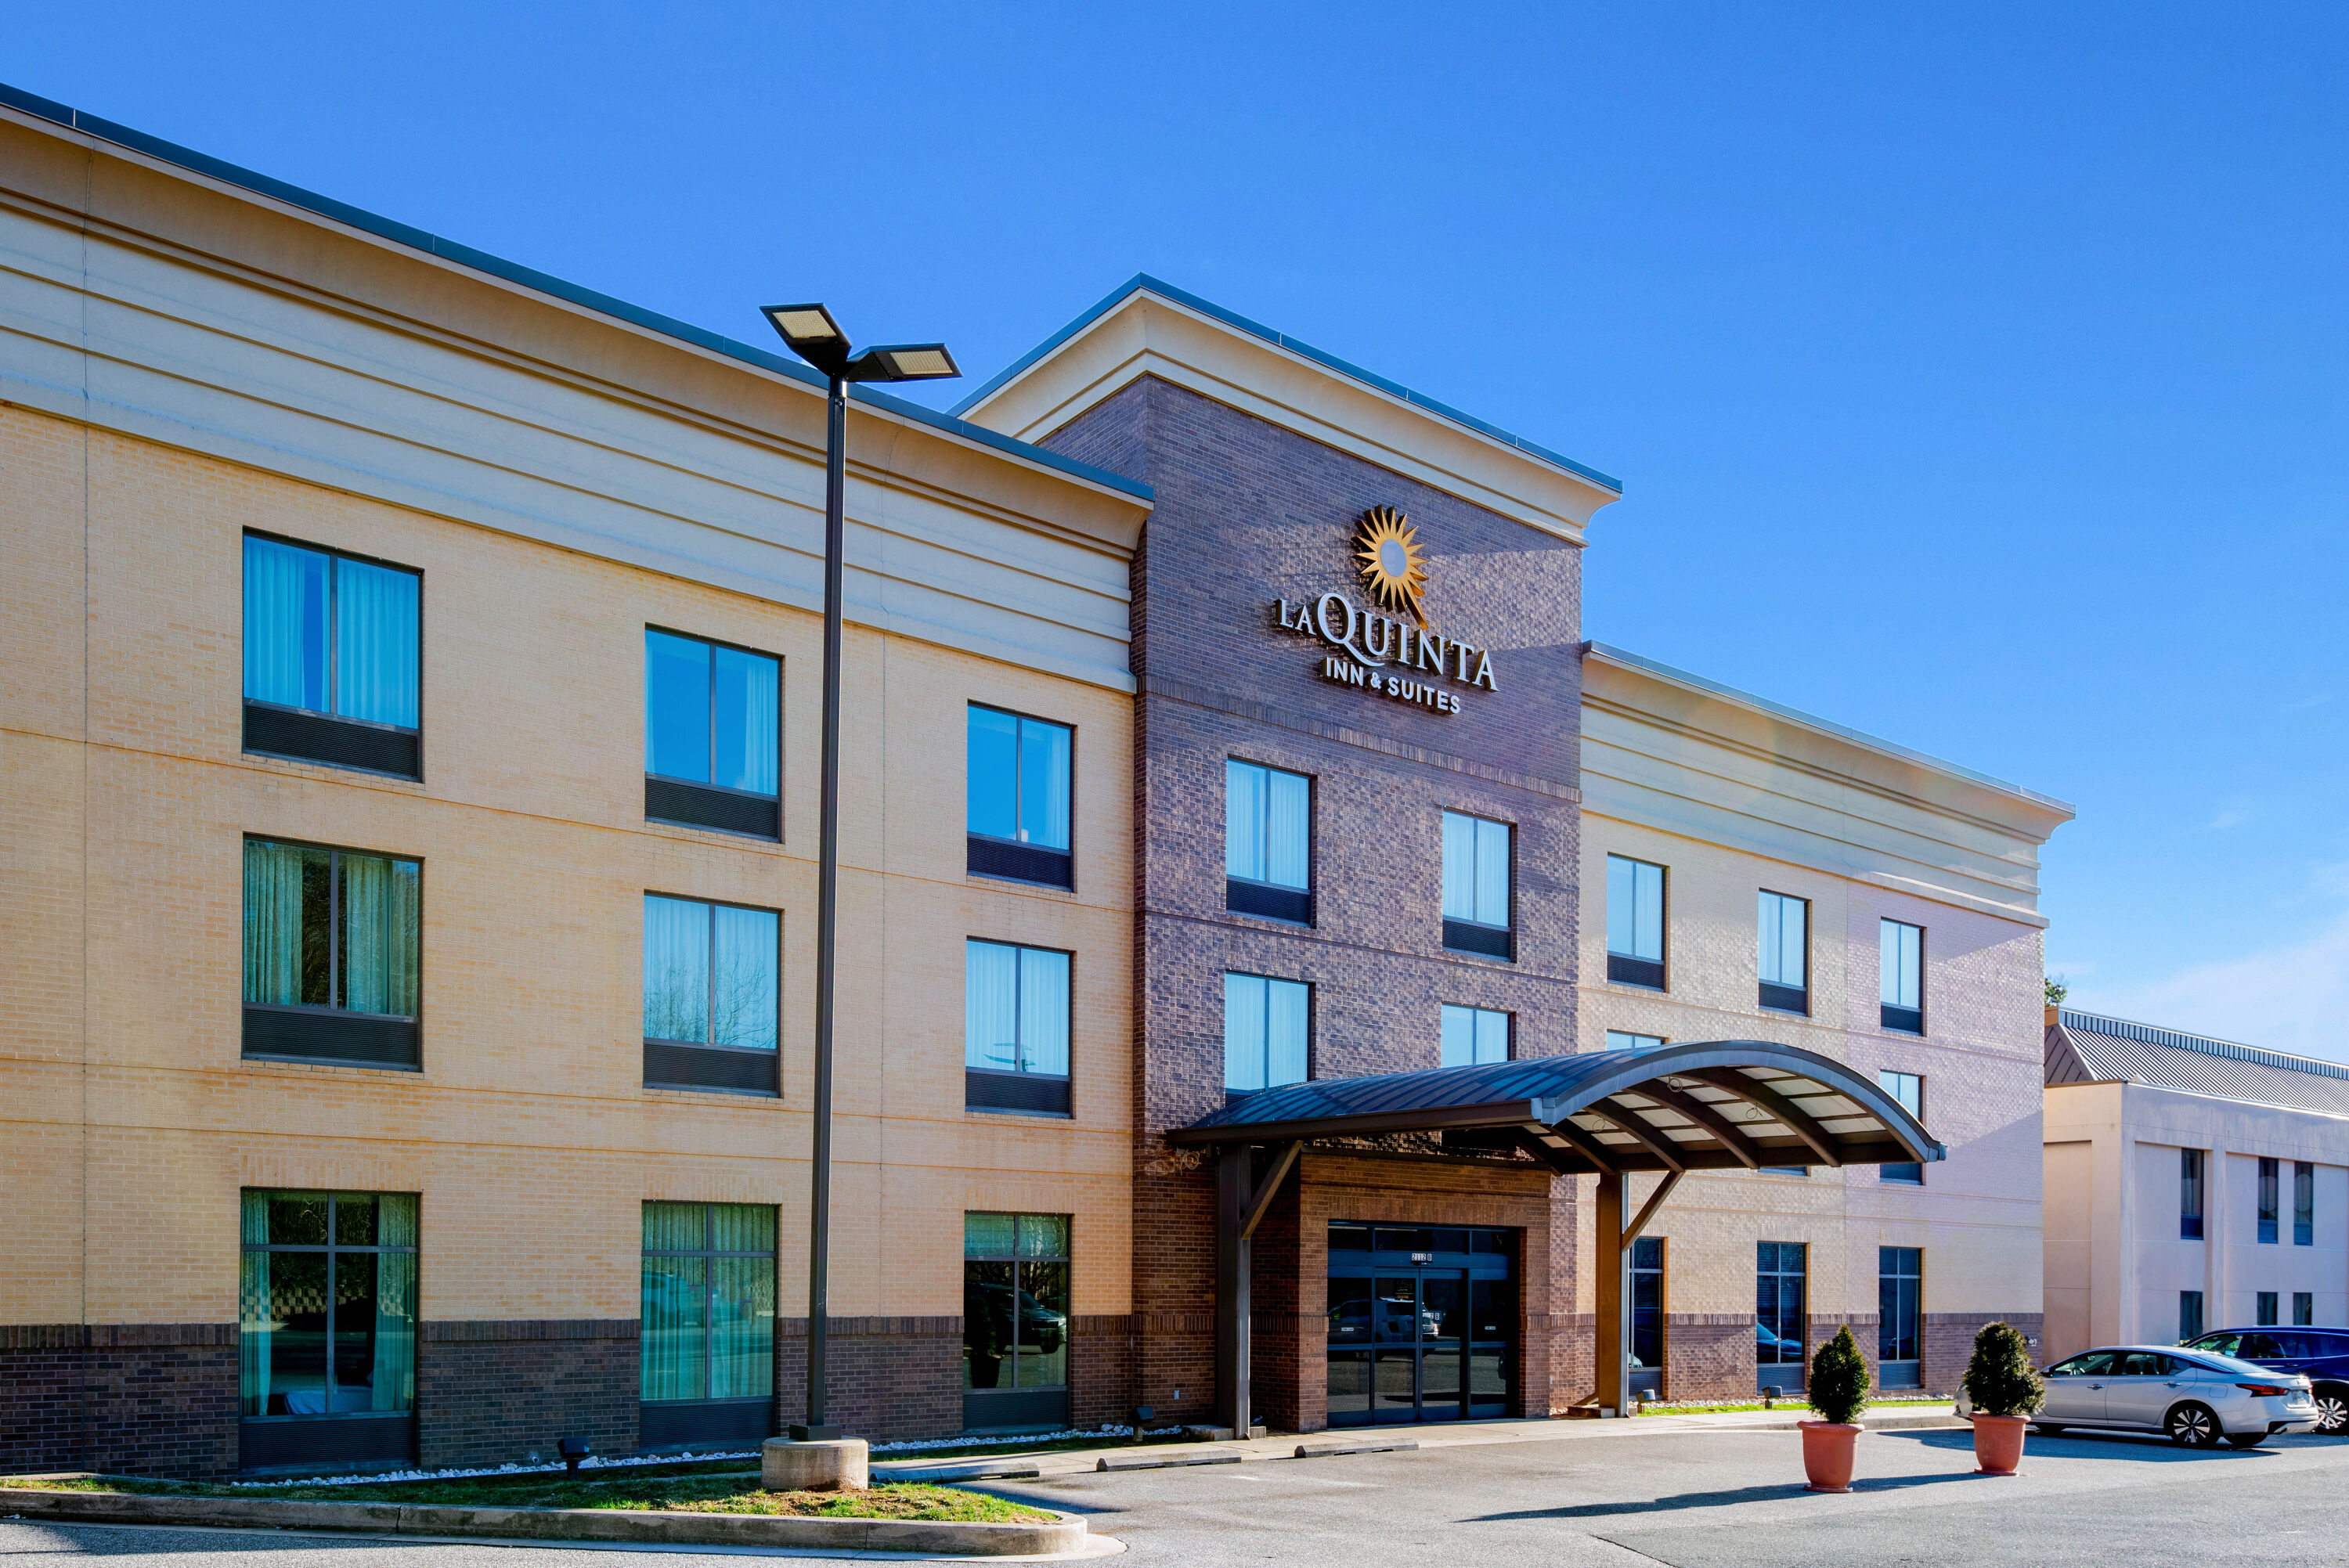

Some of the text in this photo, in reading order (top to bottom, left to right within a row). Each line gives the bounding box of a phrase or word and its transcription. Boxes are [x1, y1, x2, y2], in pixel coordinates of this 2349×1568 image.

[1277, 593, 1499, 692] LA QUINTA
[1326, 656, 1462, 715] INN & SUITES
